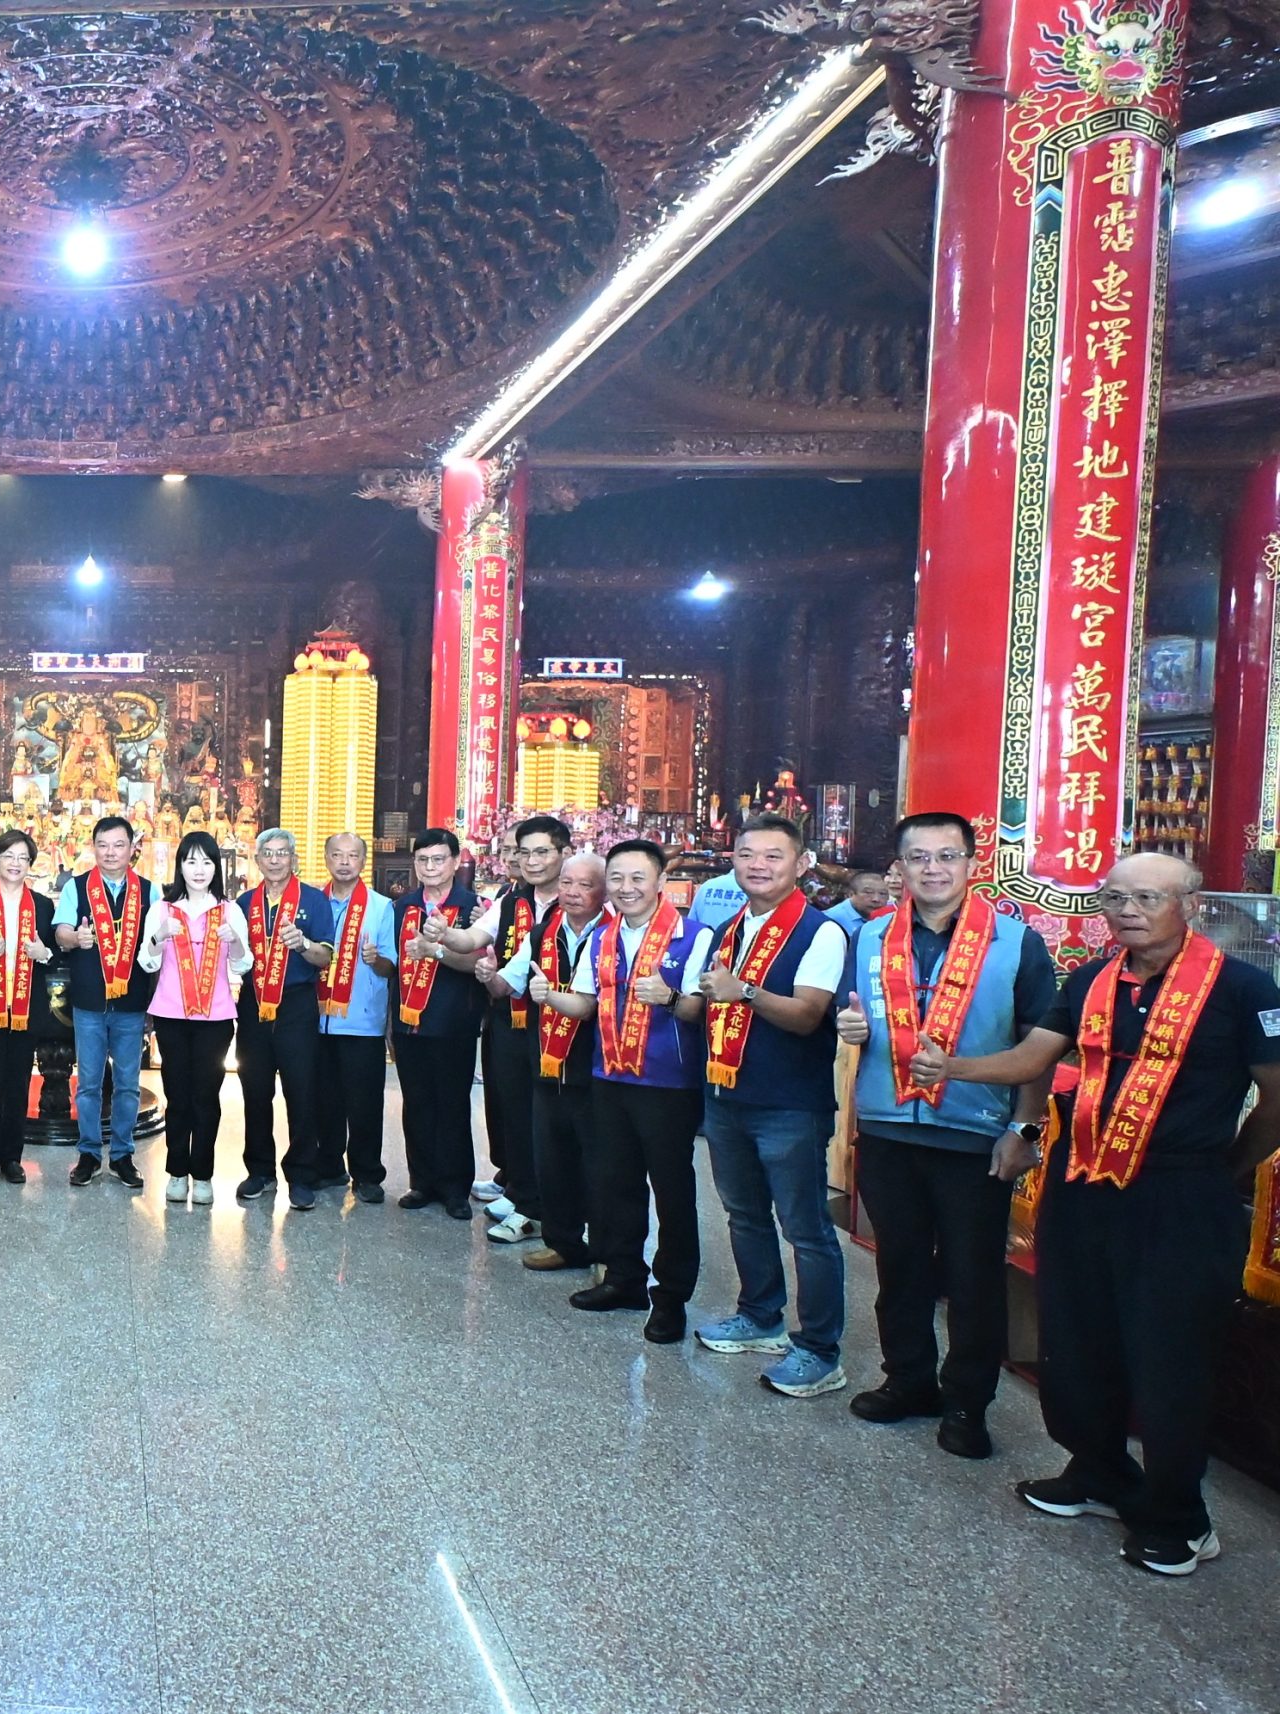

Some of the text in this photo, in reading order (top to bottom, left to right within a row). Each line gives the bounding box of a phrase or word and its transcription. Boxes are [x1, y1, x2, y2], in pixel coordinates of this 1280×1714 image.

[624, 931, 662, 1049] 彰化縣媽福文化節
[1109, 990, 1192, 1153] 彰化縣媽祖祈福文化節
